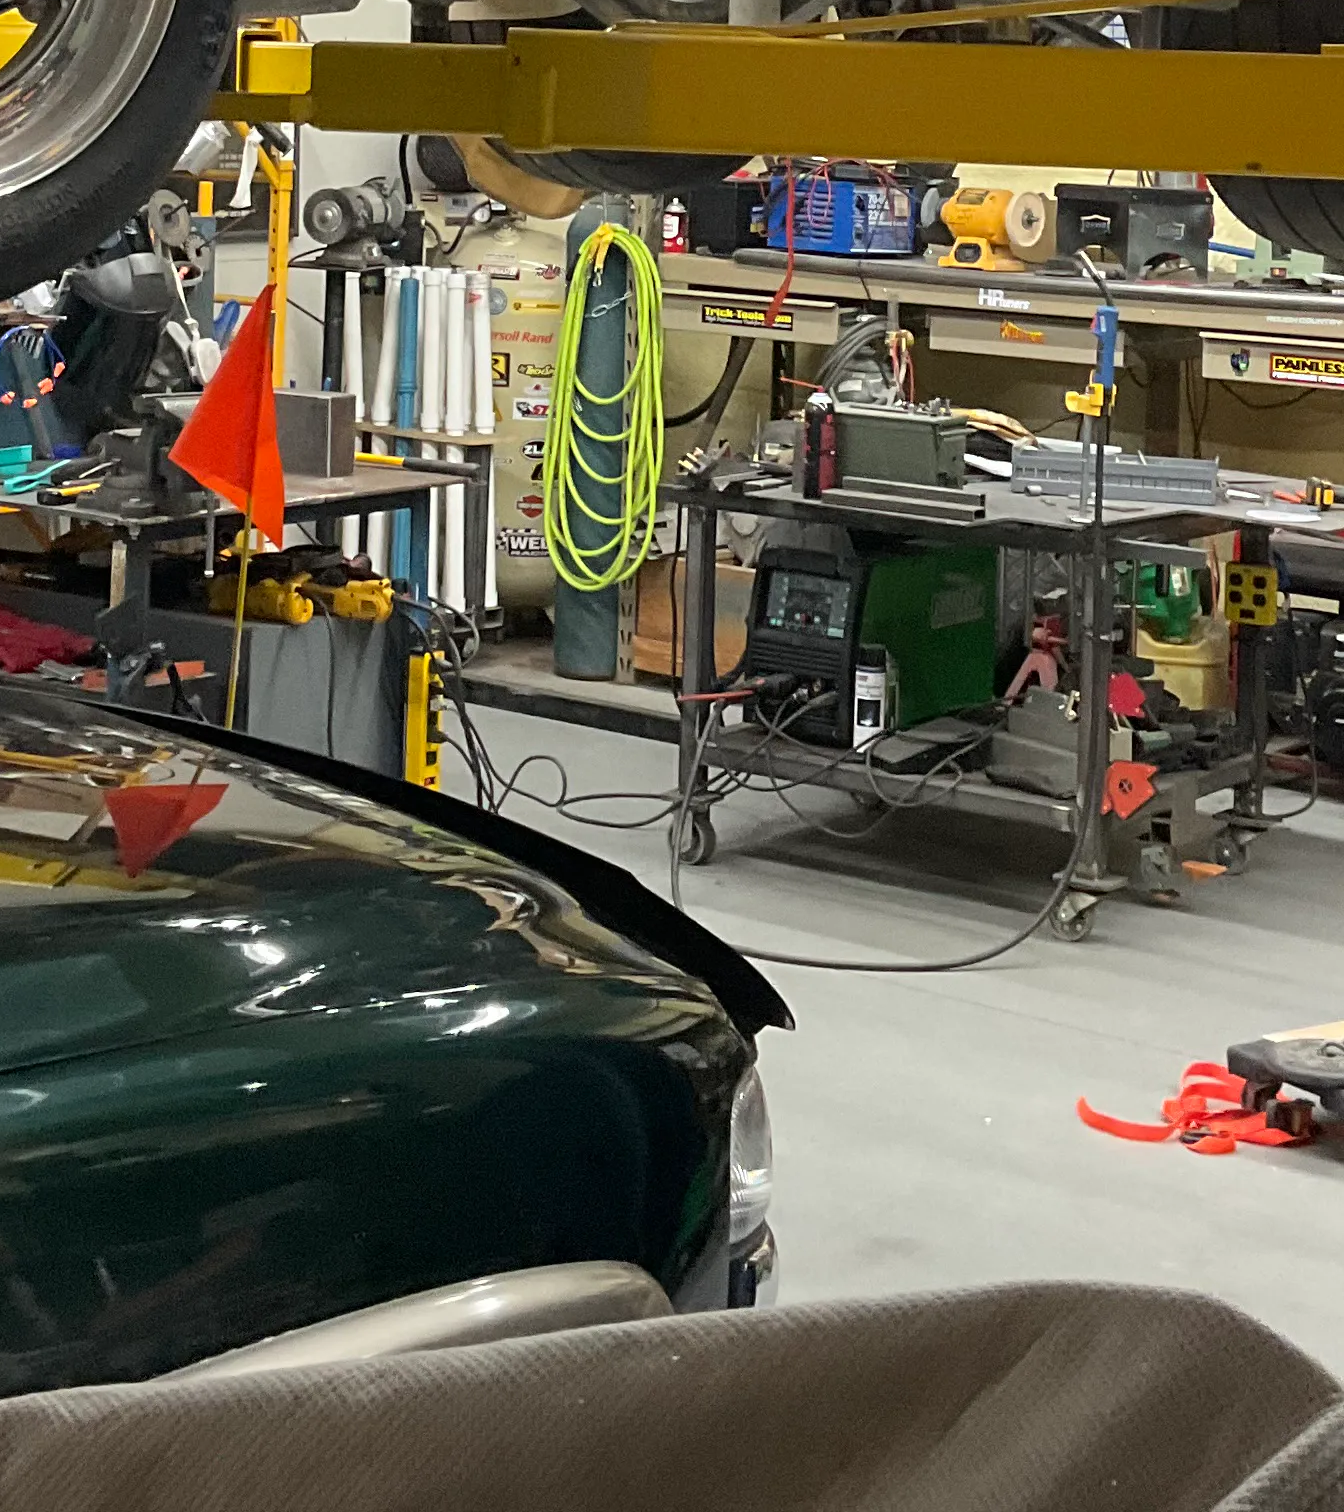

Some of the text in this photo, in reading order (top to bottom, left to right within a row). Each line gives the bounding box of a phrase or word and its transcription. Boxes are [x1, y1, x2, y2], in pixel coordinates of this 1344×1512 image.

[703, 306, 792, 324] Trick-Toolscom
[491, 330, 555, 344] rsoll Rand
[510, 535, 549, 551] WEL
